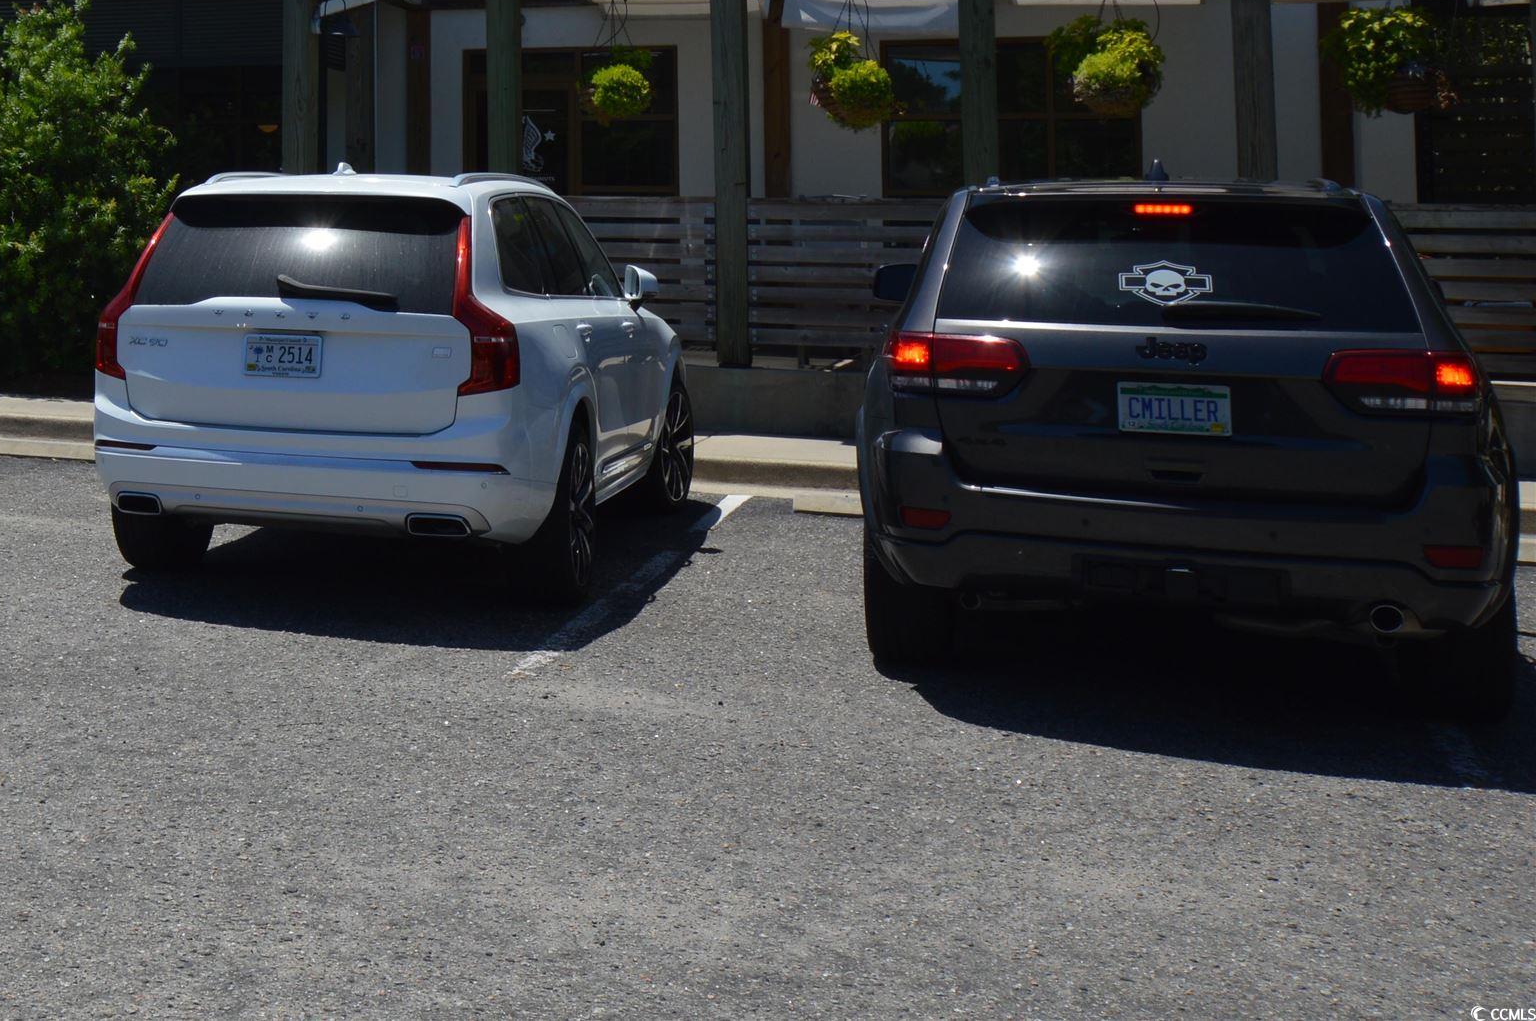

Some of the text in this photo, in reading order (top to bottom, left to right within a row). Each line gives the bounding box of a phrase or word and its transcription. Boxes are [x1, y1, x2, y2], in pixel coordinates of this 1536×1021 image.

[266, 345, 313, 365] M 2514
[266, 354, 273, 363] C
[1136, 337, 1207, 363] Jeep
[1128, 396, 1219, 423] CMILLER
